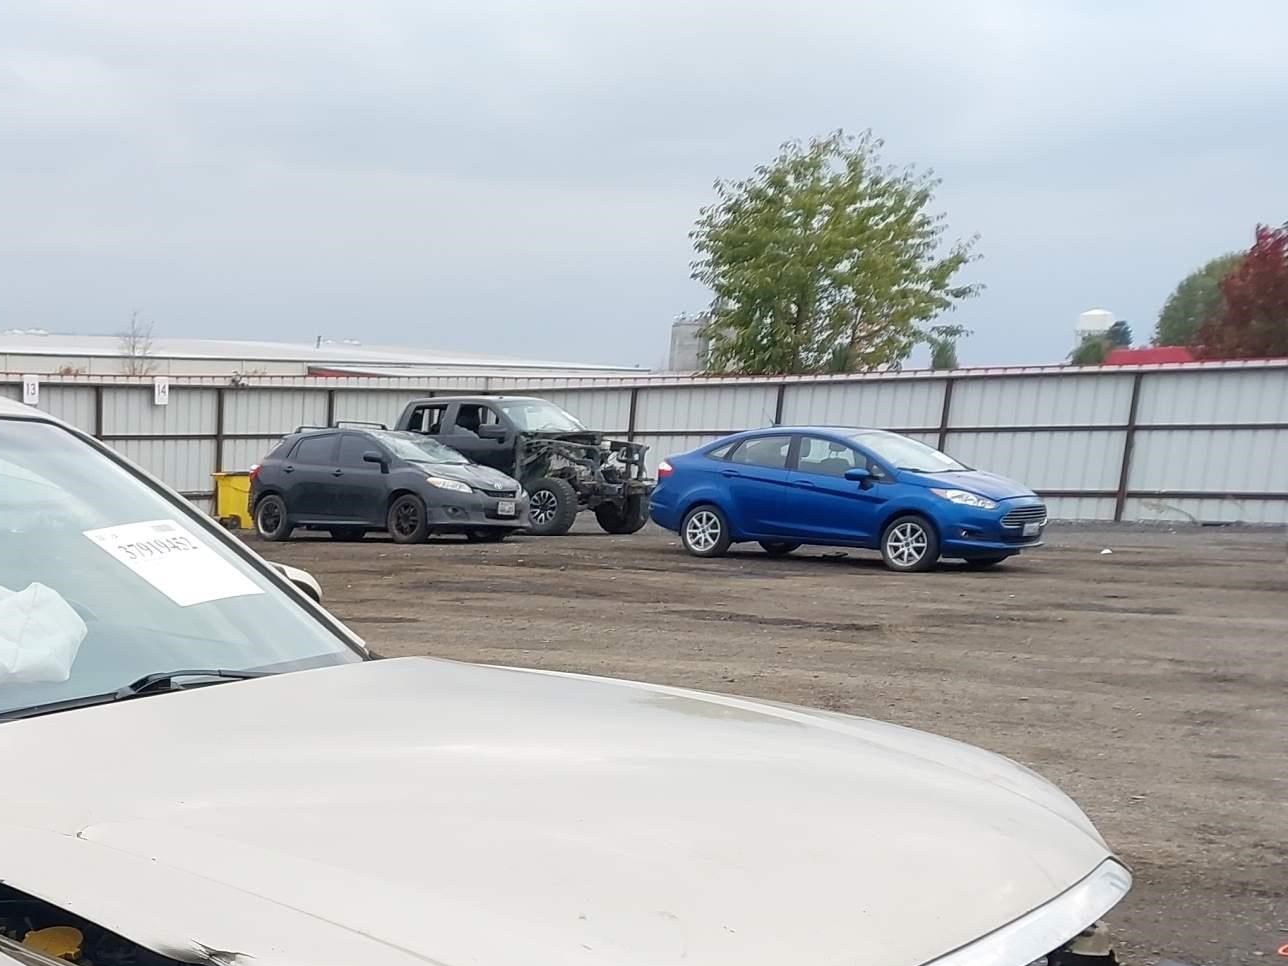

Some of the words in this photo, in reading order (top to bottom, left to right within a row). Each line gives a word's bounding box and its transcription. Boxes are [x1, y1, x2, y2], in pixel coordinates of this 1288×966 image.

[26, 383, 36, 396] 13
[157, 383, 167, 396] 14
[117, 536, 199, 560] 37919452
